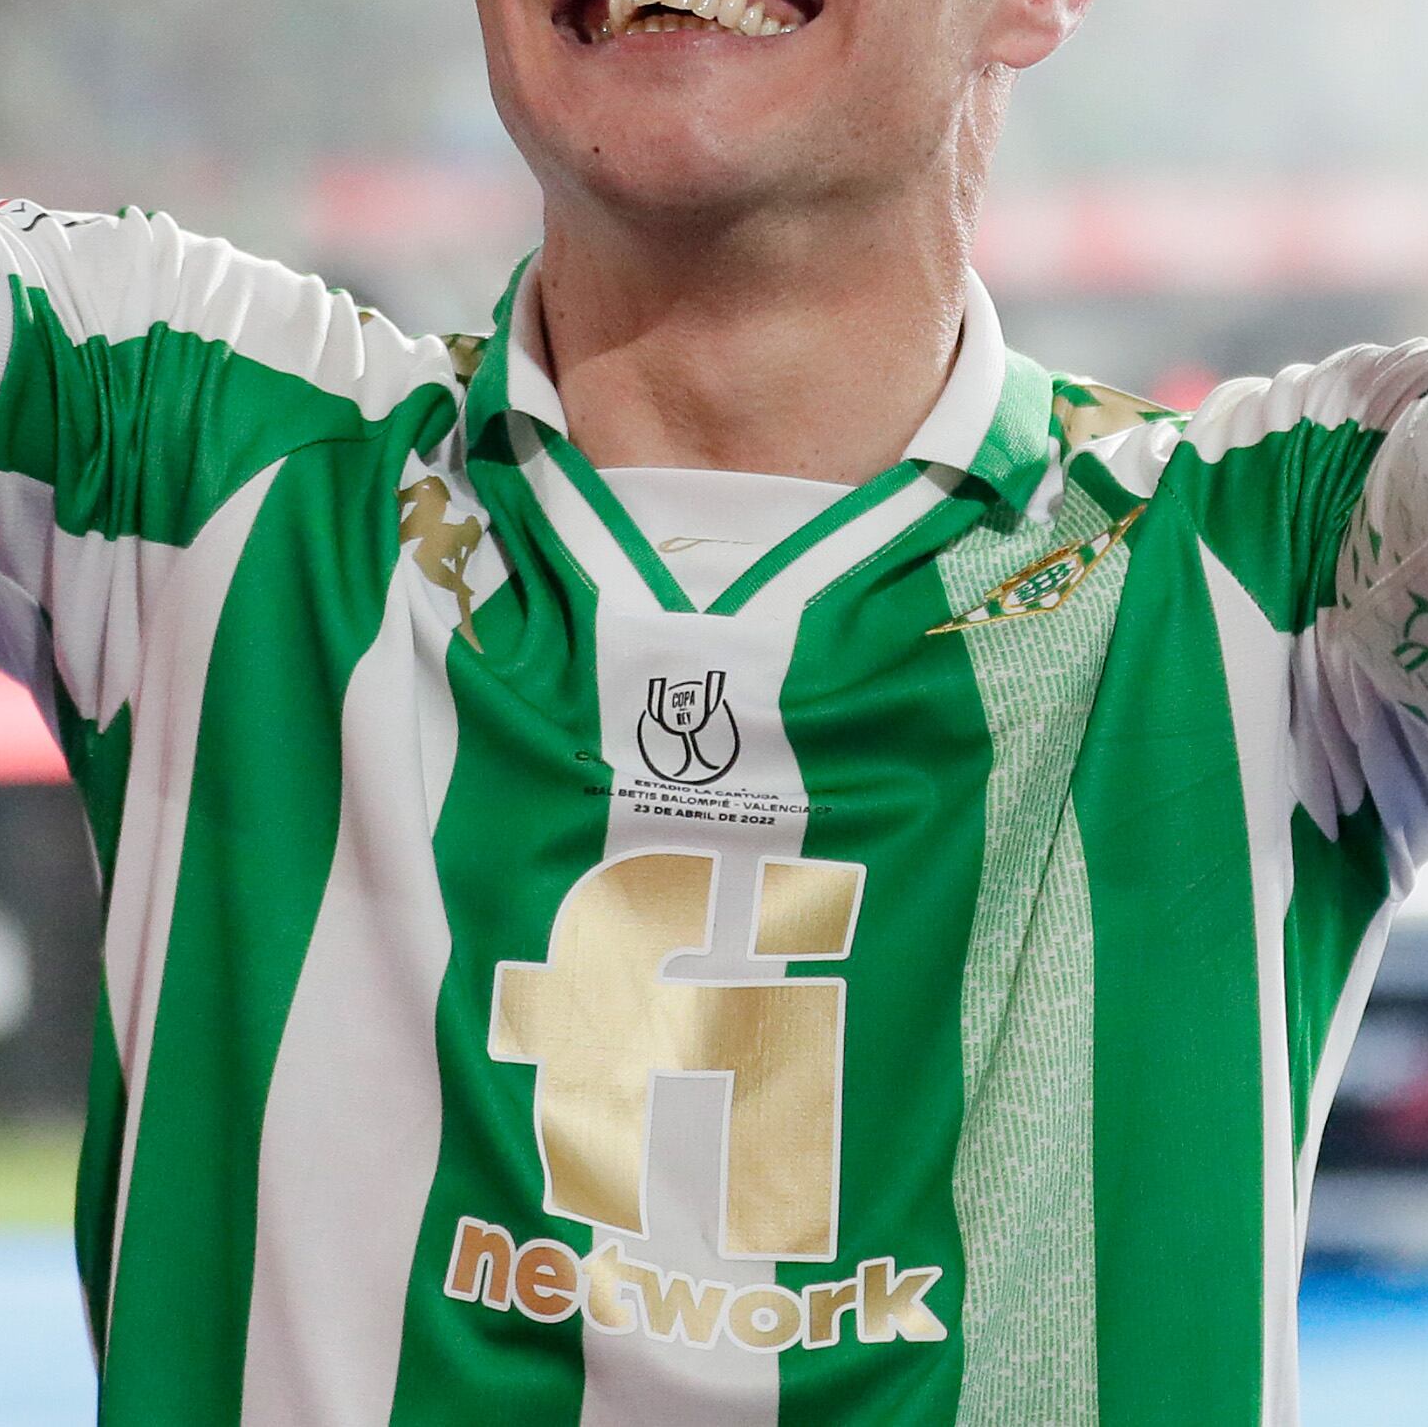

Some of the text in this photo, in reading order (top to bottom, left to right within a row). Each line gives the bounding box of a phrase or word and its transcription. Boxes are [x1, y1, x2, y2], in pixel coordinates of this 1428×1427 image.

[672, 690, 695, 709] COPA
[634, 779, 691, 793] ESTADIO
[583, 786, 615, 797] REAL
[618, 788, 657, 801] BETIS
[661, 793, 730, 808] BALOMPIÉ
[743, 802, 811, 814] VALENCIA
[633, 804, 776, 825] 23 DE ABRIL DE 2022
[444, 1216, 948, 1353] network
